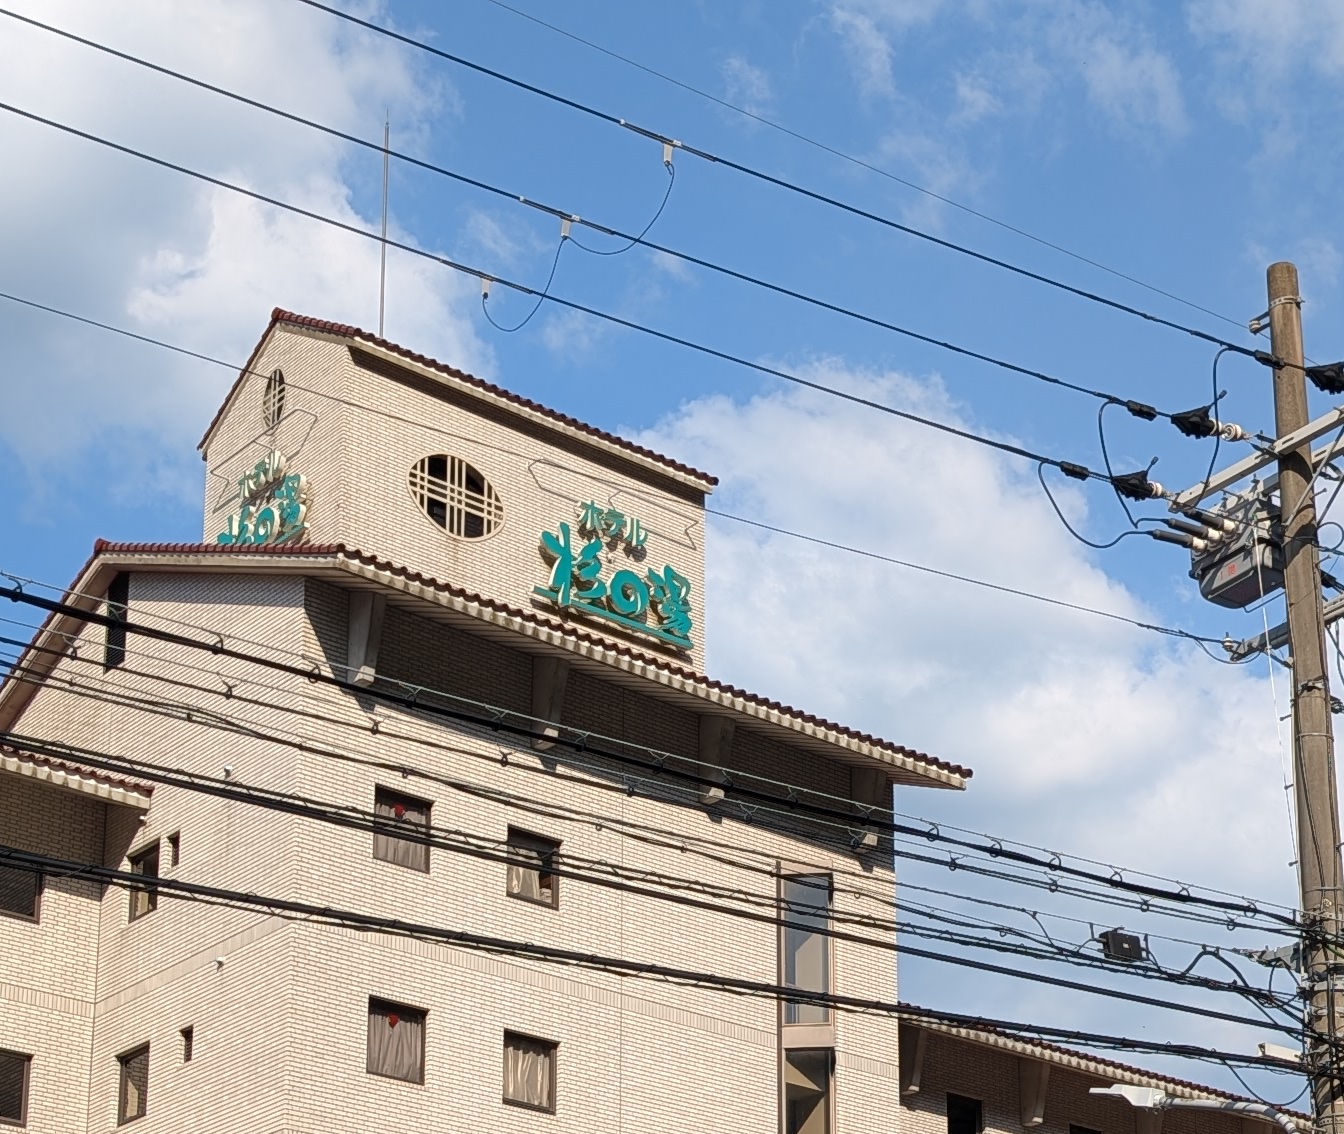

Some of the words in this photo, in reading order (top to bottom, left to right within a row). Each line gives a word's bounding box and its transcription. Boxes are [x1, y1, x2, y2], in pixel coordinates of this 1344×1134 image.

[576, 500, 648, 547] ホテル
[540, 522, 692, 638] 杉の湯
